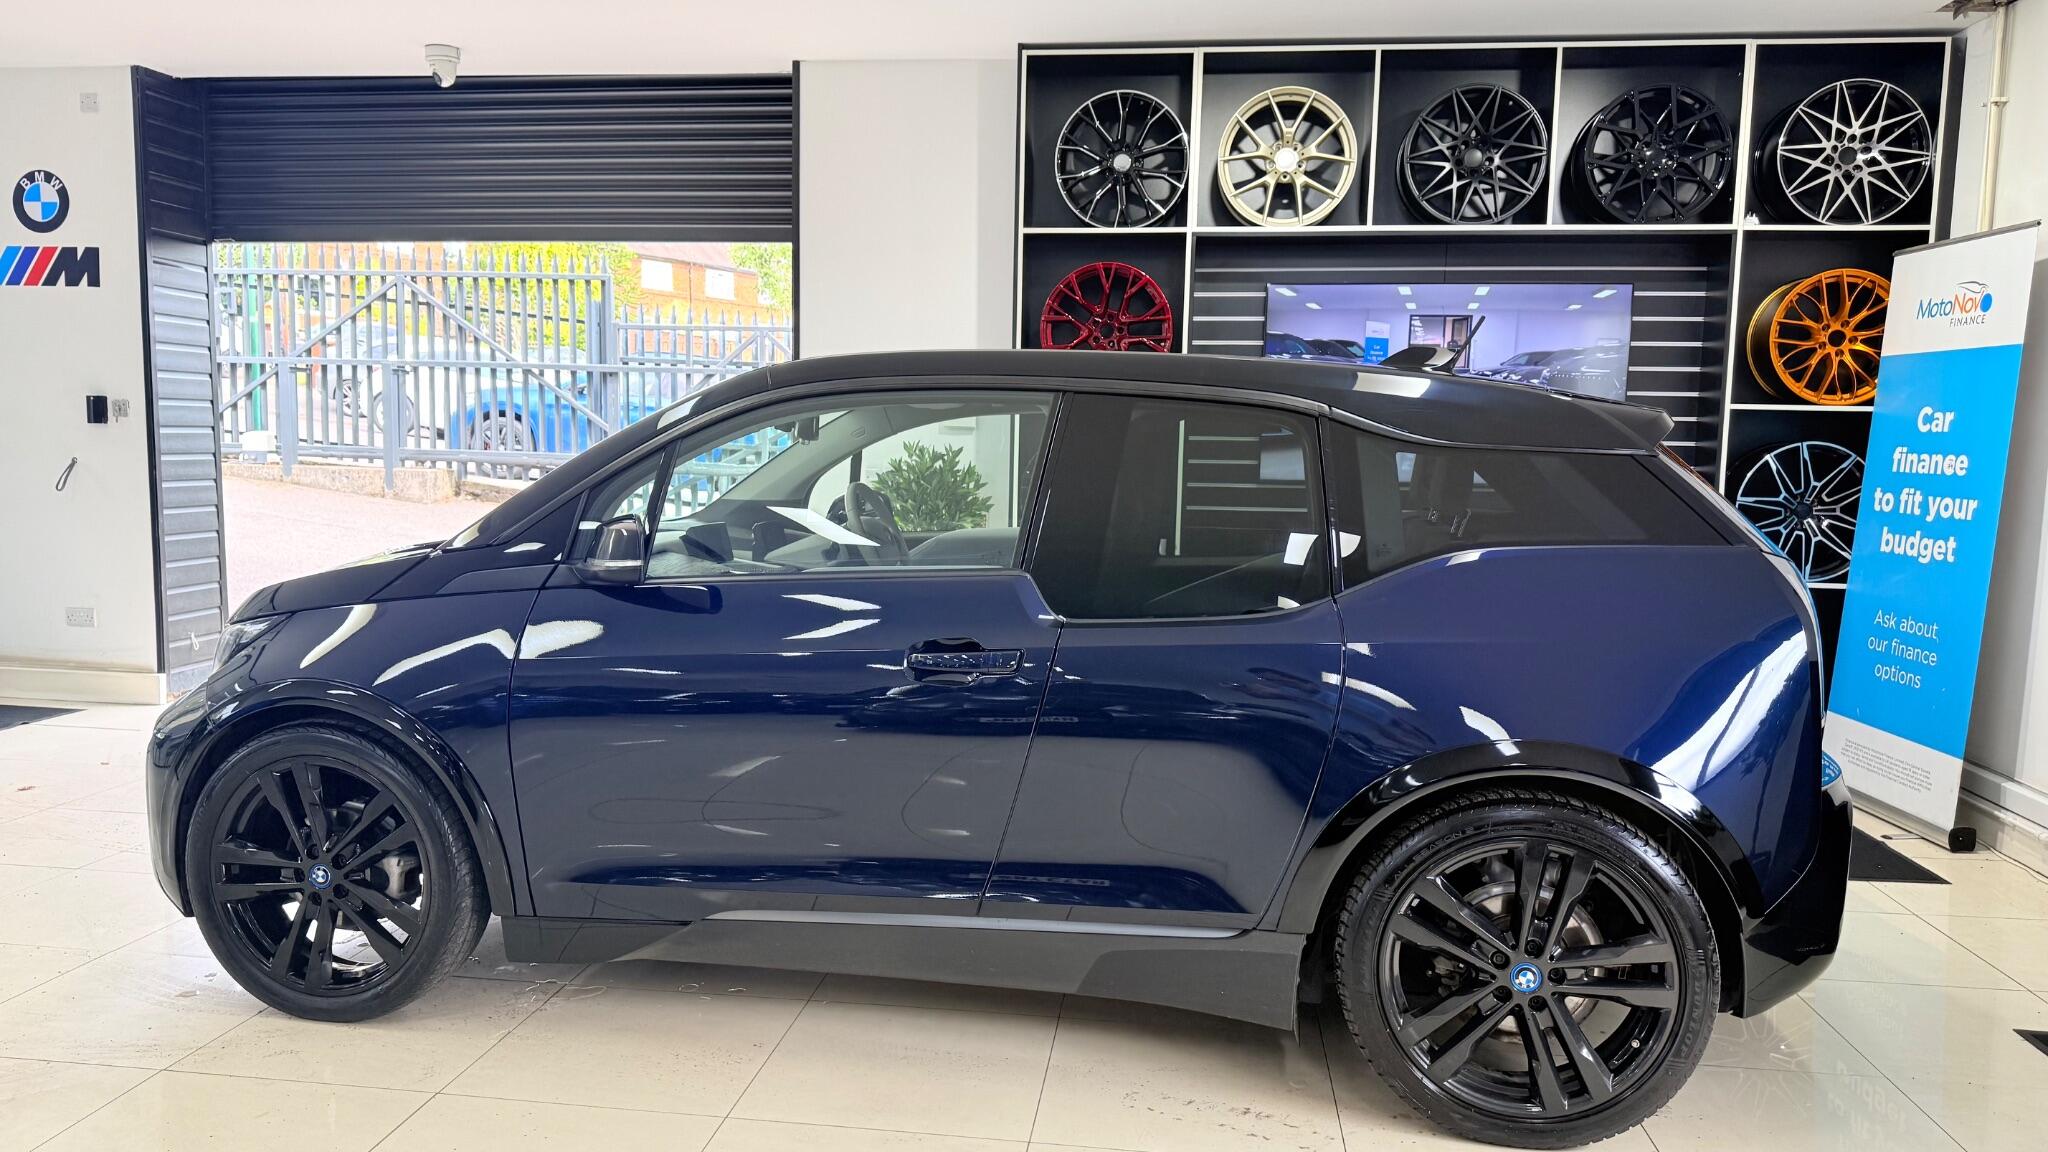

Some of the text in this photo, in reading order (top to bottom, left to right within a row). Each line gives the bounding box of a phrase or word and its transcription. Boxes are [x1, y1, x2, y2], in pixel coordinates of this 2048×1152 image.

[20, 171, 63, 191] BMW
[1949, 315, 1986, 327] FINANCE
[1917, 406, 1955, 432] Car
[1892, 446, 1968, 476] finance
[1873, 487, 1978, 522] to fit your
[1880, 526, 1956, 563] budget
[1874, 609, 1939, 639] Ask about
[1868, 637, 1937, 666] our finance
[1875, 664, 1921, 688] options
